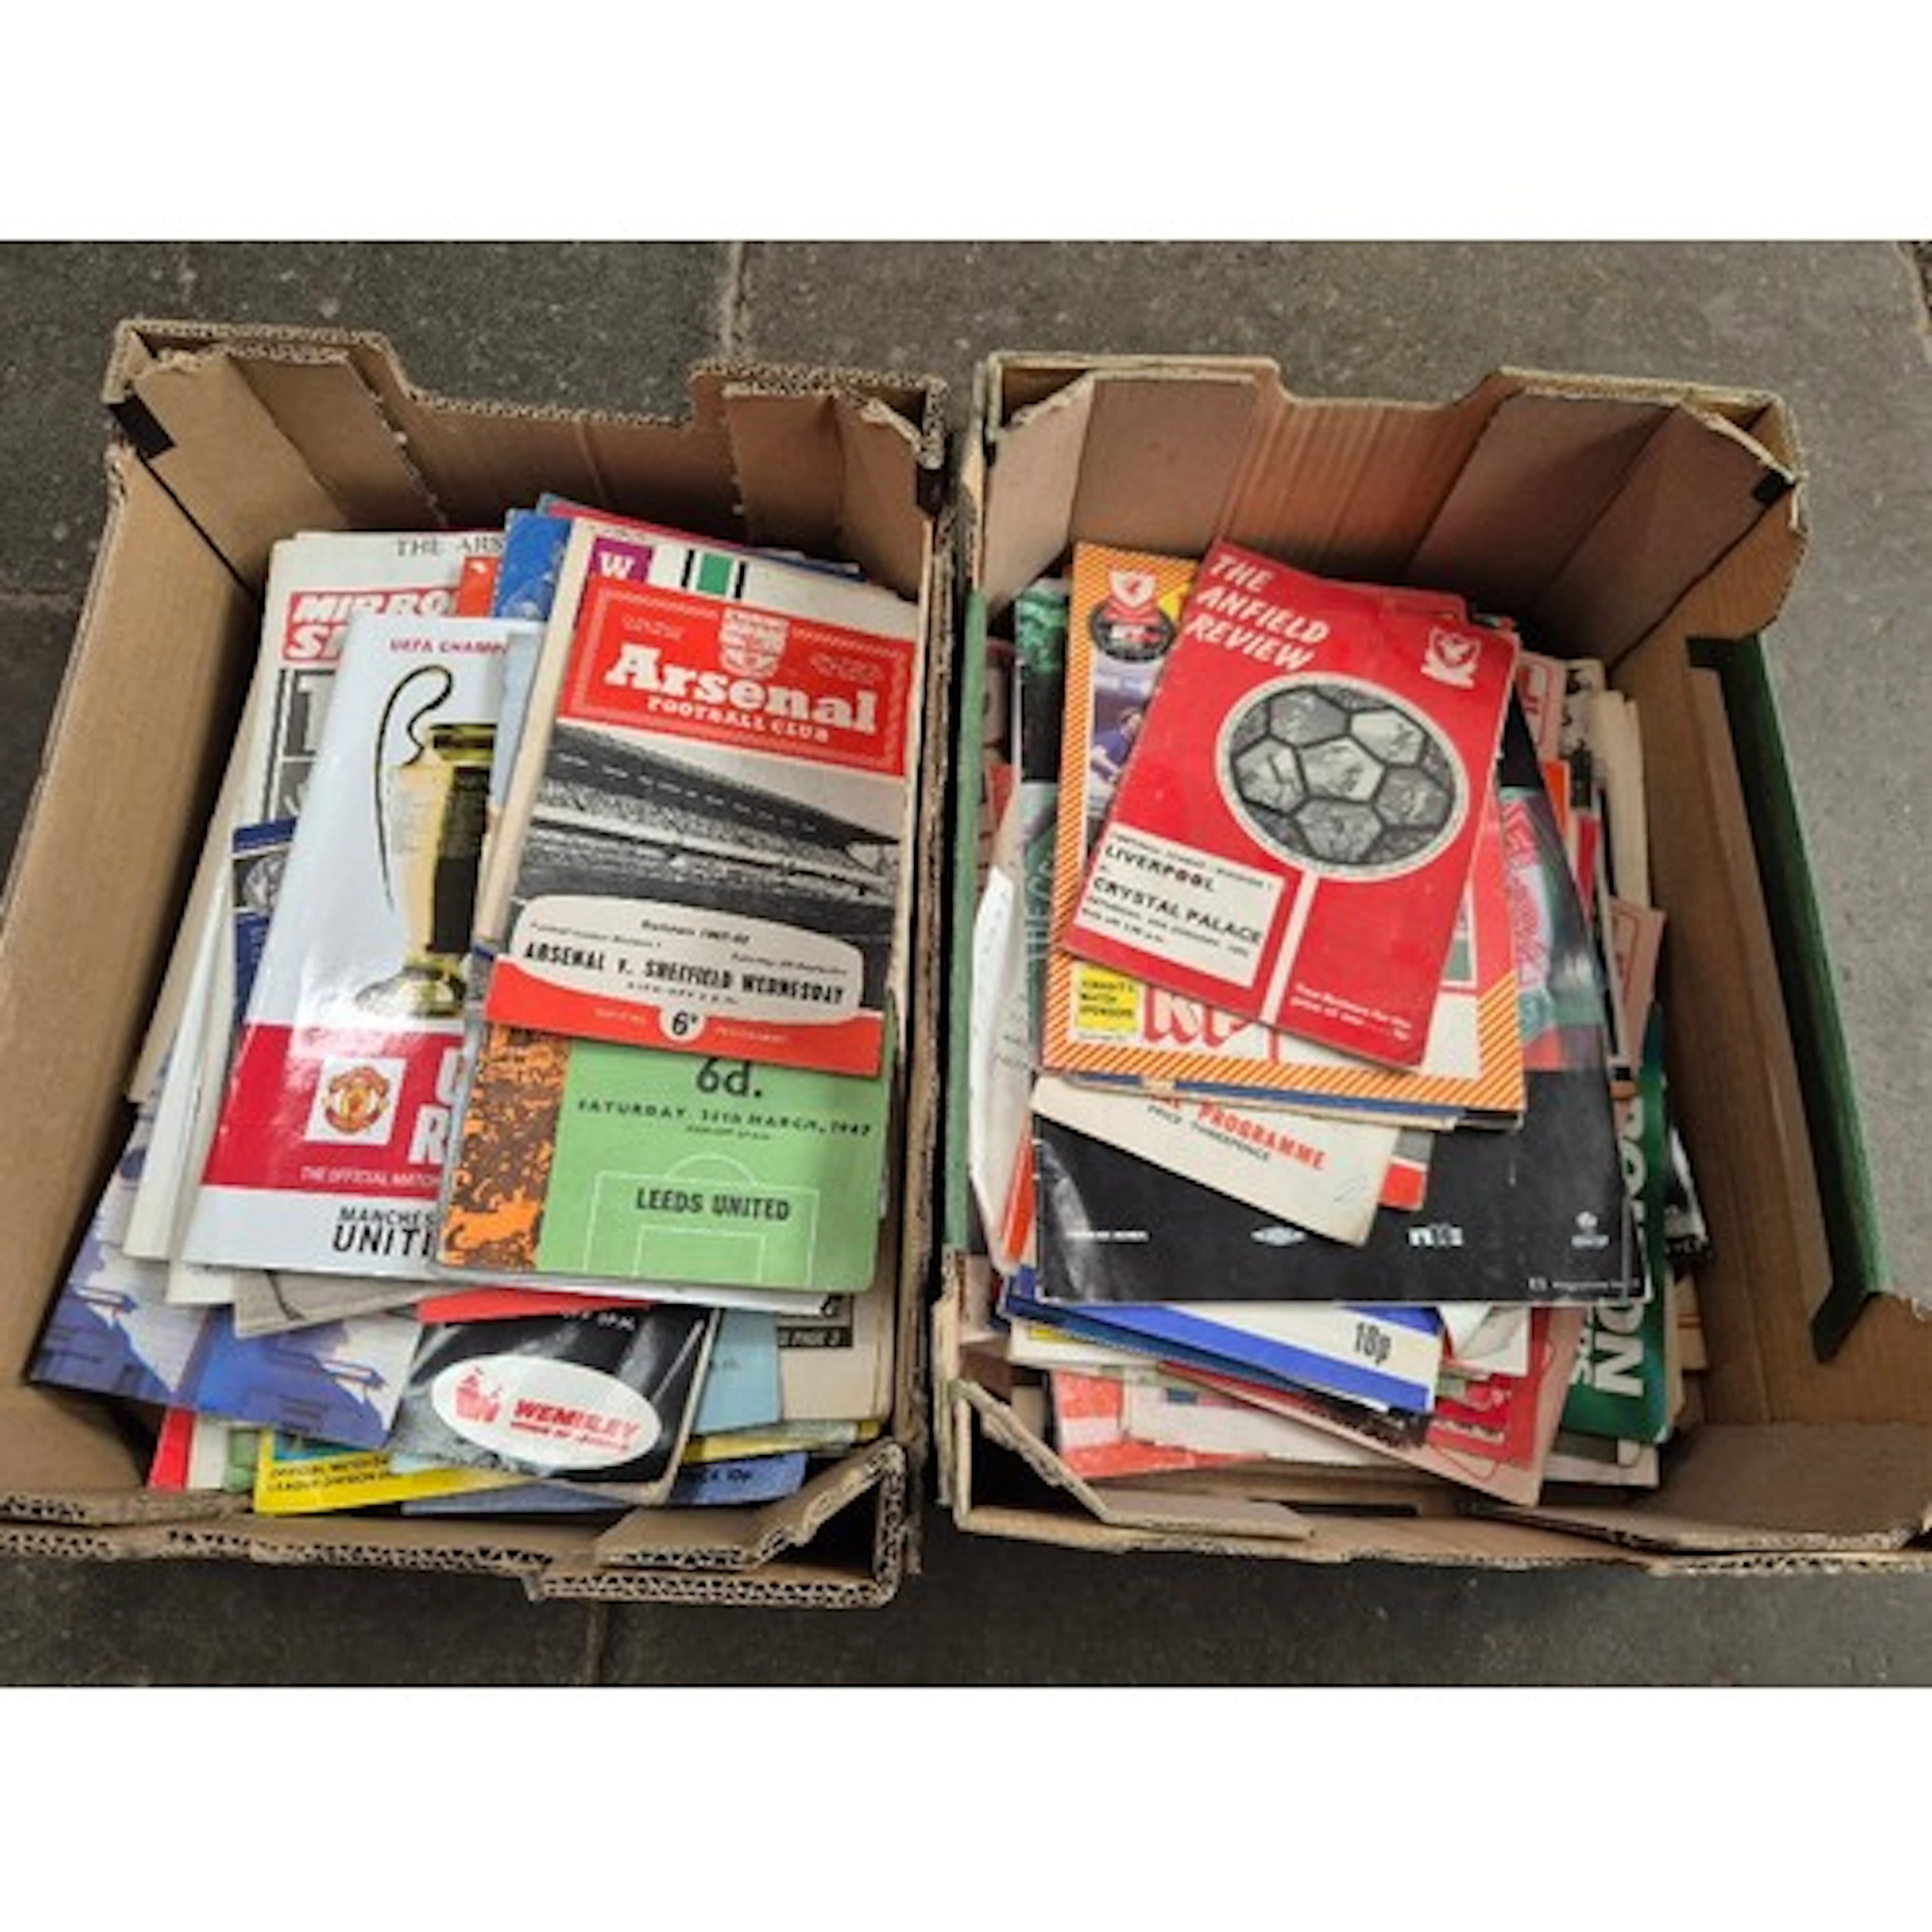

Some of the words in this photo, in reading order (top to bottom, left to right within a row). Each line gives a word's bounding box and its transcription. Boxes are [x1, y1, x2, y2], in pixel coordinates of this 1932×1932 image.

[1209, 554, 1275, 592] THE
[1184, 614, 1316, 671] REVIEW
[1195, 585, 1331, 644] ANFIELD
[605, 643, 878, 734] Arsenal
[648, 696, 766, 732] FOOTBALL
[771, 719, 830, 743] CLUB
[1105, 845, 1216, 894] LIVERPOOL
[1093, 876, 1180, 919] CRYSTAL
[1185, 907, 1262, 944] PALACE
[525, 942, 606, 971] ARSENAL
[644, 958, 733, 988] SHEFFIELD
[742, 973, 844, 1004] WEDNESDAY
[1196, 1102, 1327, 1170] PROGRAMME
[637, 1188, 702, 1214] LEEDS
[711, 1194, 791, 1221] UNITED
